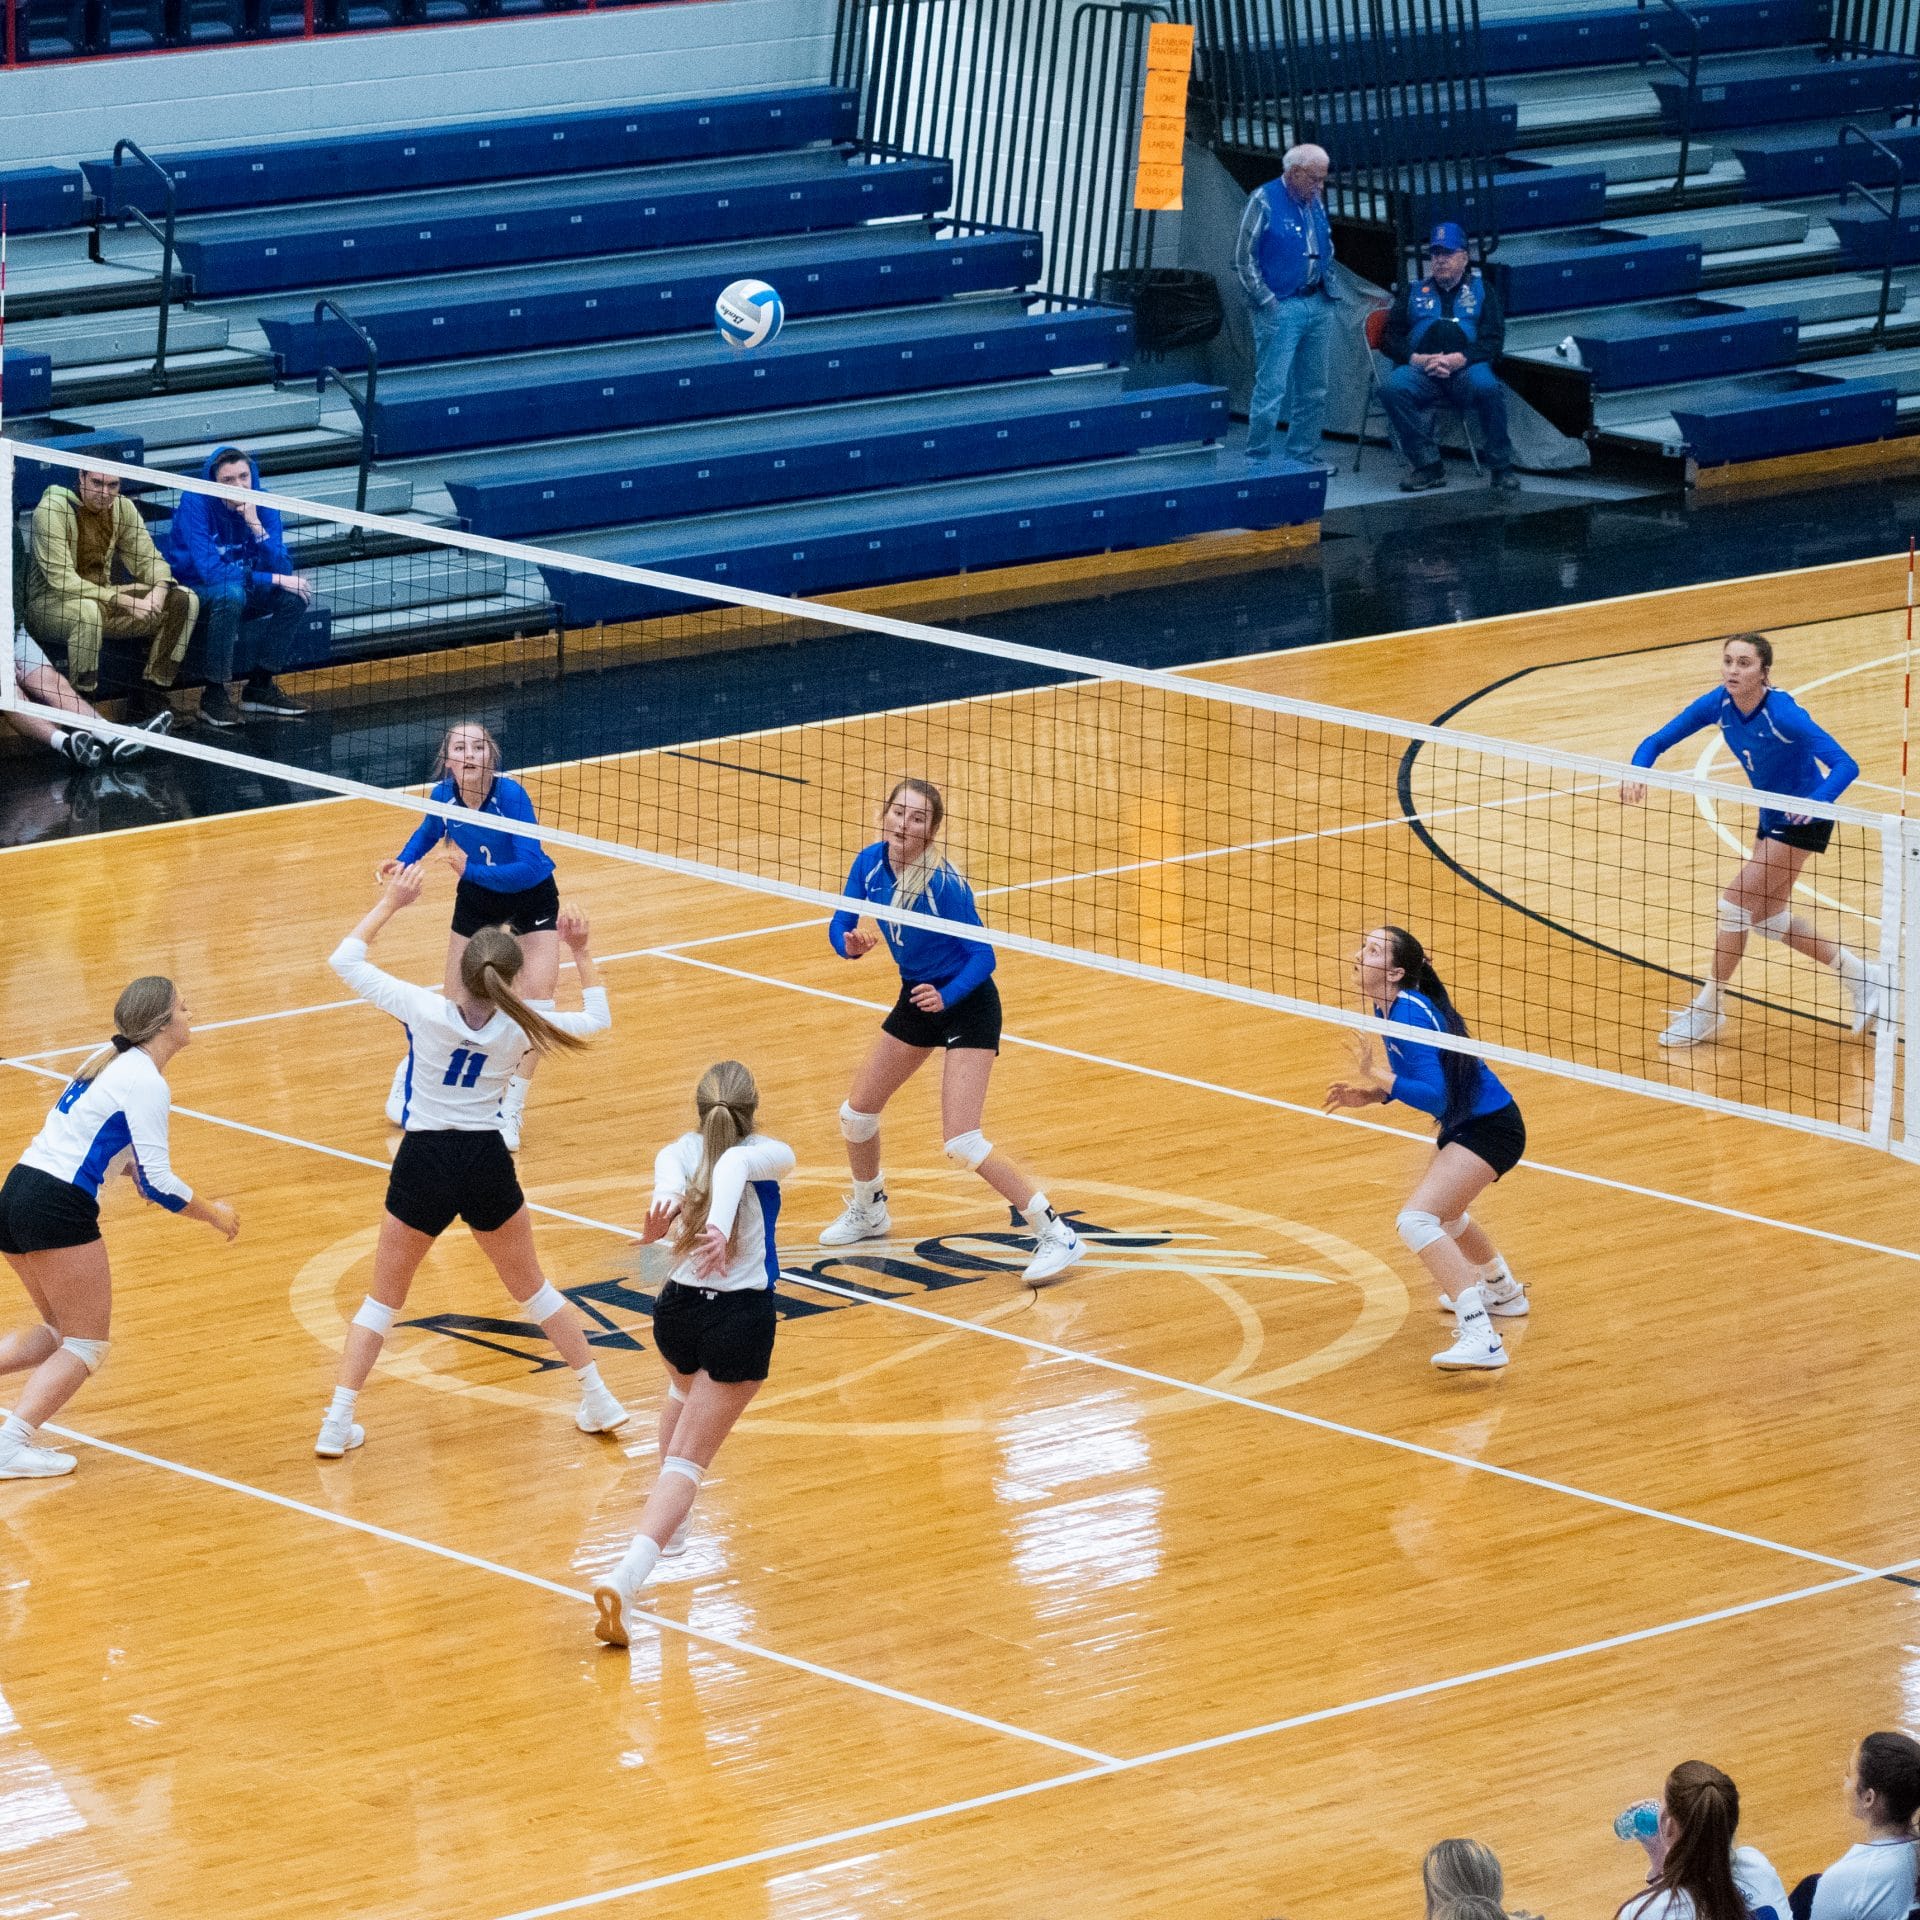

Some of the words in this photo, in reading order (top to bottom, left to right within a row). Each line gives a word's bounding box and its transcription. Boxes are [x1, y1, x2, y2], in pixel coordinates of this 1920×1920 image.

[1151, 37, 1190, 48] GLENBURN
[1158, 75, 1178, 84] RYAN
[1147, 141, 1176, 150] LAKERS
[479, 844, 497, 867] 2
[442, 1047, 489, 1089] 11
[393, 1205, 1173, 1374] Mnot
